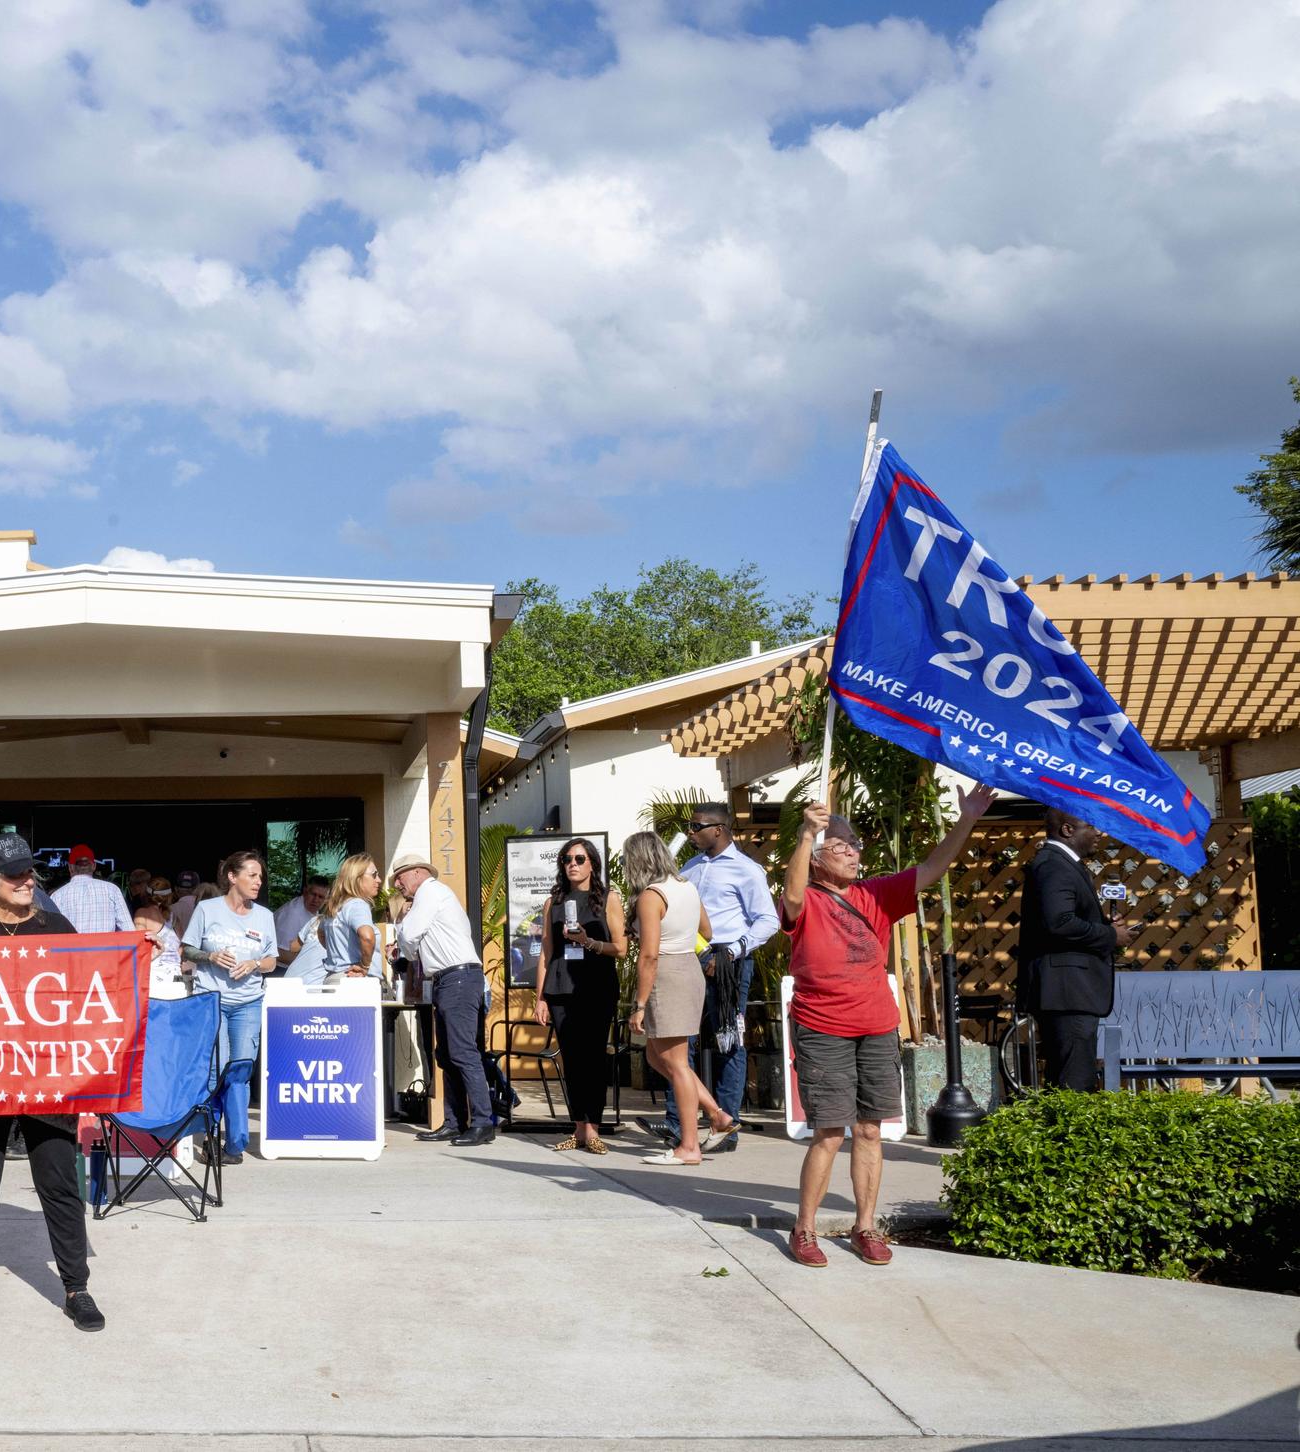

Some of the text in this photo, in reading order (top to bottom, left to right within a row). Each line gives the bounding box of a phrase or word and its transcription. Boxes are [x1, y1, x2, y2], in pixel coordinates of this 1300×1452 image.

[928, 631, 1130, 755] 2024
[841, 660, 1173, 814] MAKE AMERICA GREAT AGAIN
[438, 760, 456, 876] 27421
[292, 1024, 350, 1034] DONALDS
[279, 1083, 364, 1104] ENTRY
[297, 1060, 343, 1081] VIP
